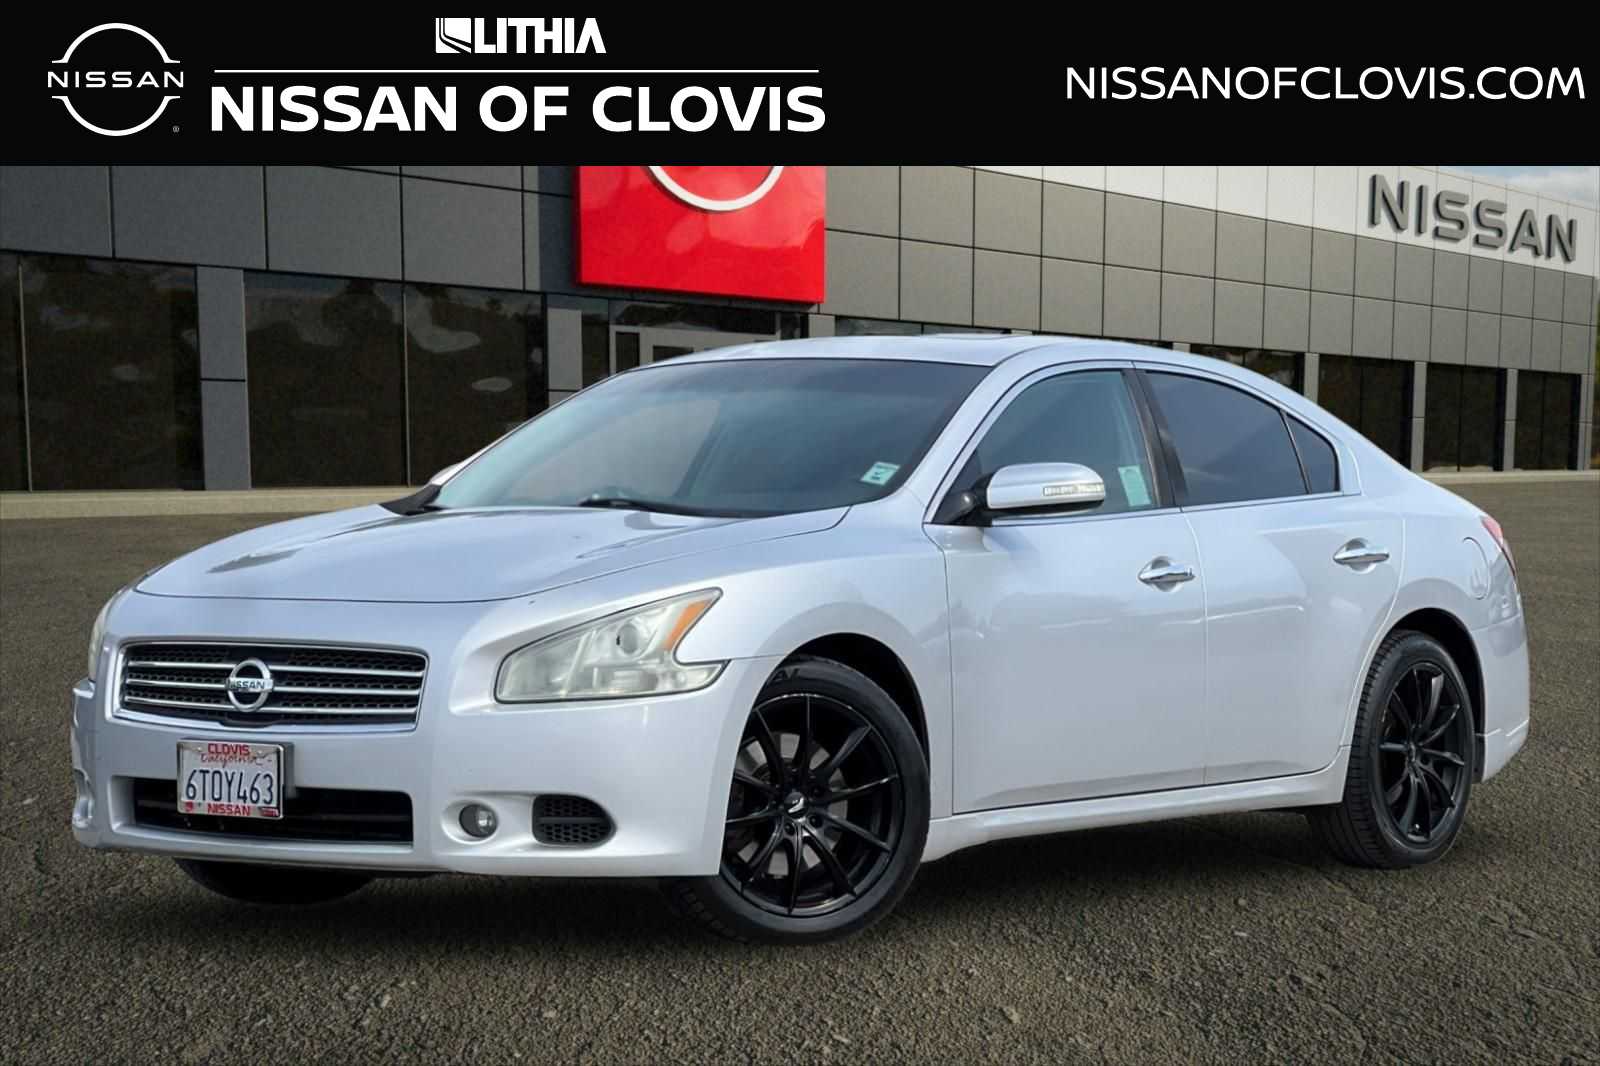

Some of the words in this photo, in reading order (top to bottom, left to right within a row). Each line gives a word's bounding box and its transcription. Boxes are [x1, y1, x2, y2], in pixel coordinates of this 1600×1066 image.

[1368, 174, 1578, 263] NISSAN
[208, 743, 250, 756] CLOVIS
[207, 803, 251, 816] NISSAN
